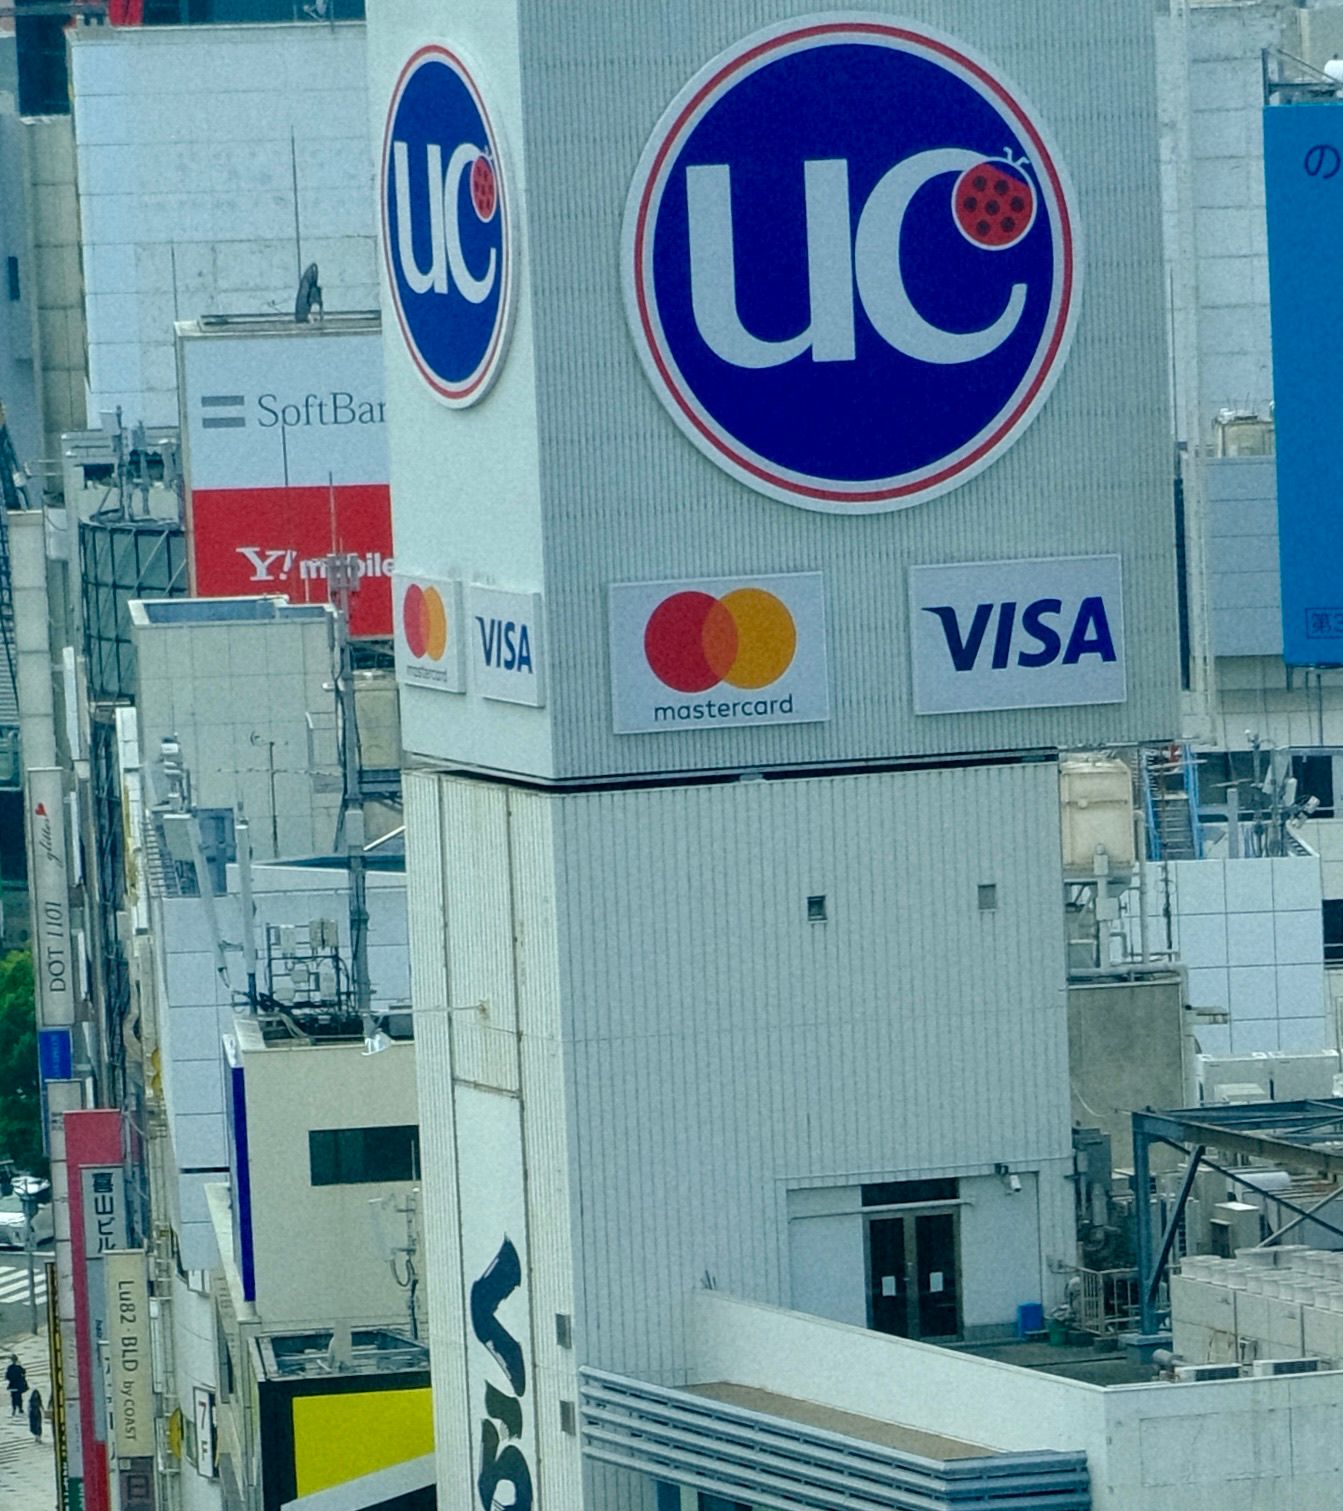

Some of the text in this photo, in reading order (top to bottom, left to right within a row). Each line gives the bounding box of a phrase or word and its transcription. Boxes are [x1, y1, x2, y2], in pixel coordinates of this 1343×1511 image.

[394, 140, 497, 304] UC
[685, 148, 1027, 367] UC
[475, 614, 533, 673] VISA
[922, 596, 1116, 673] VISA
[653, 691, 794, 722] mastercard
[48, 946, 66, 993] DOT
[122, 1335, 141, 1373] BLD
[122, 1398, 138, 1441] COAST
